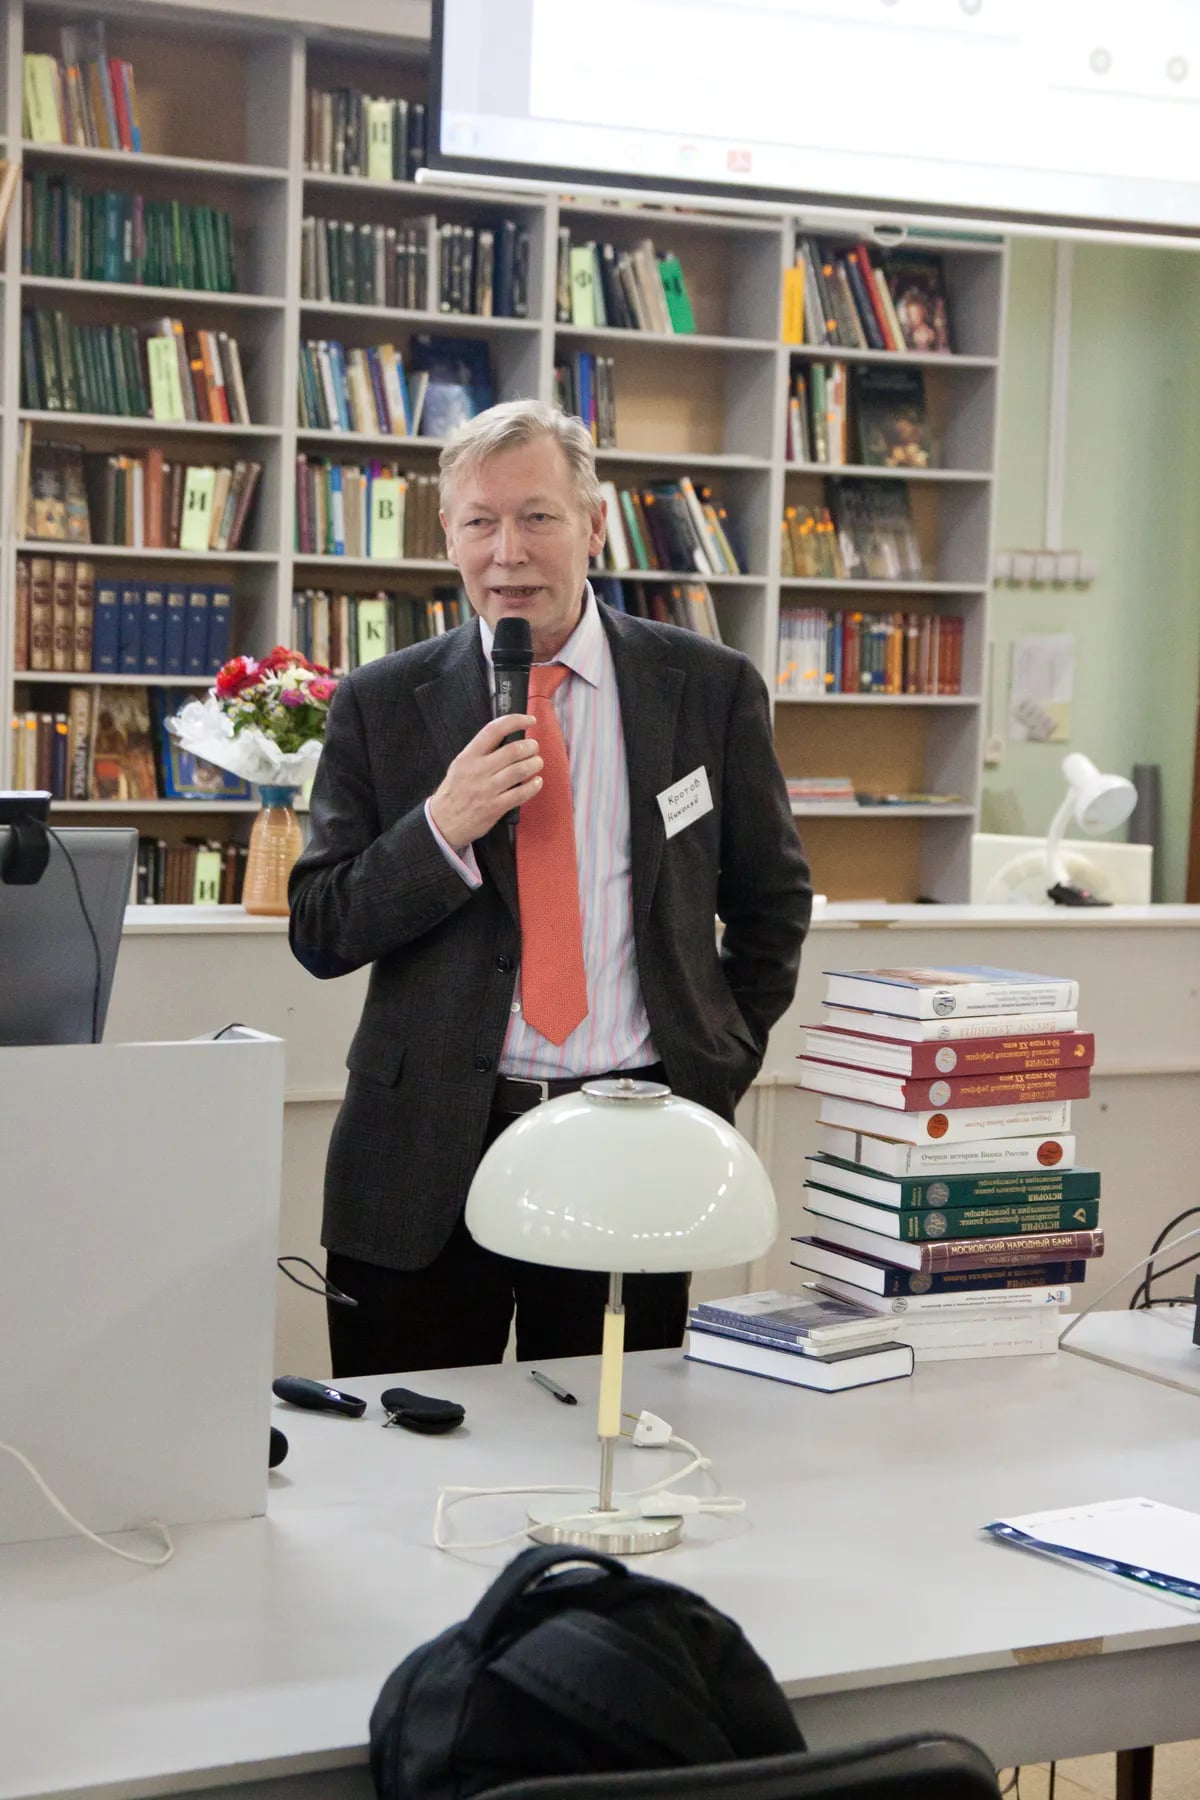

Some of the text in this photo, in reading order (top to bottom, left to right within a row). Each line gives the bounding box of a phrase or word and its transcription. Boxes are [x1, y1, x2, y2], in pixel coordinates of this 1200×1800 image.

[366, 620, 384, 641] К
[1021, 1221, 1060, 1232] ИСТОРИЯ
[951, 1237, 1073, 1255] МОСКОВСКИЙ НАРОДНЫЙ БАНК
